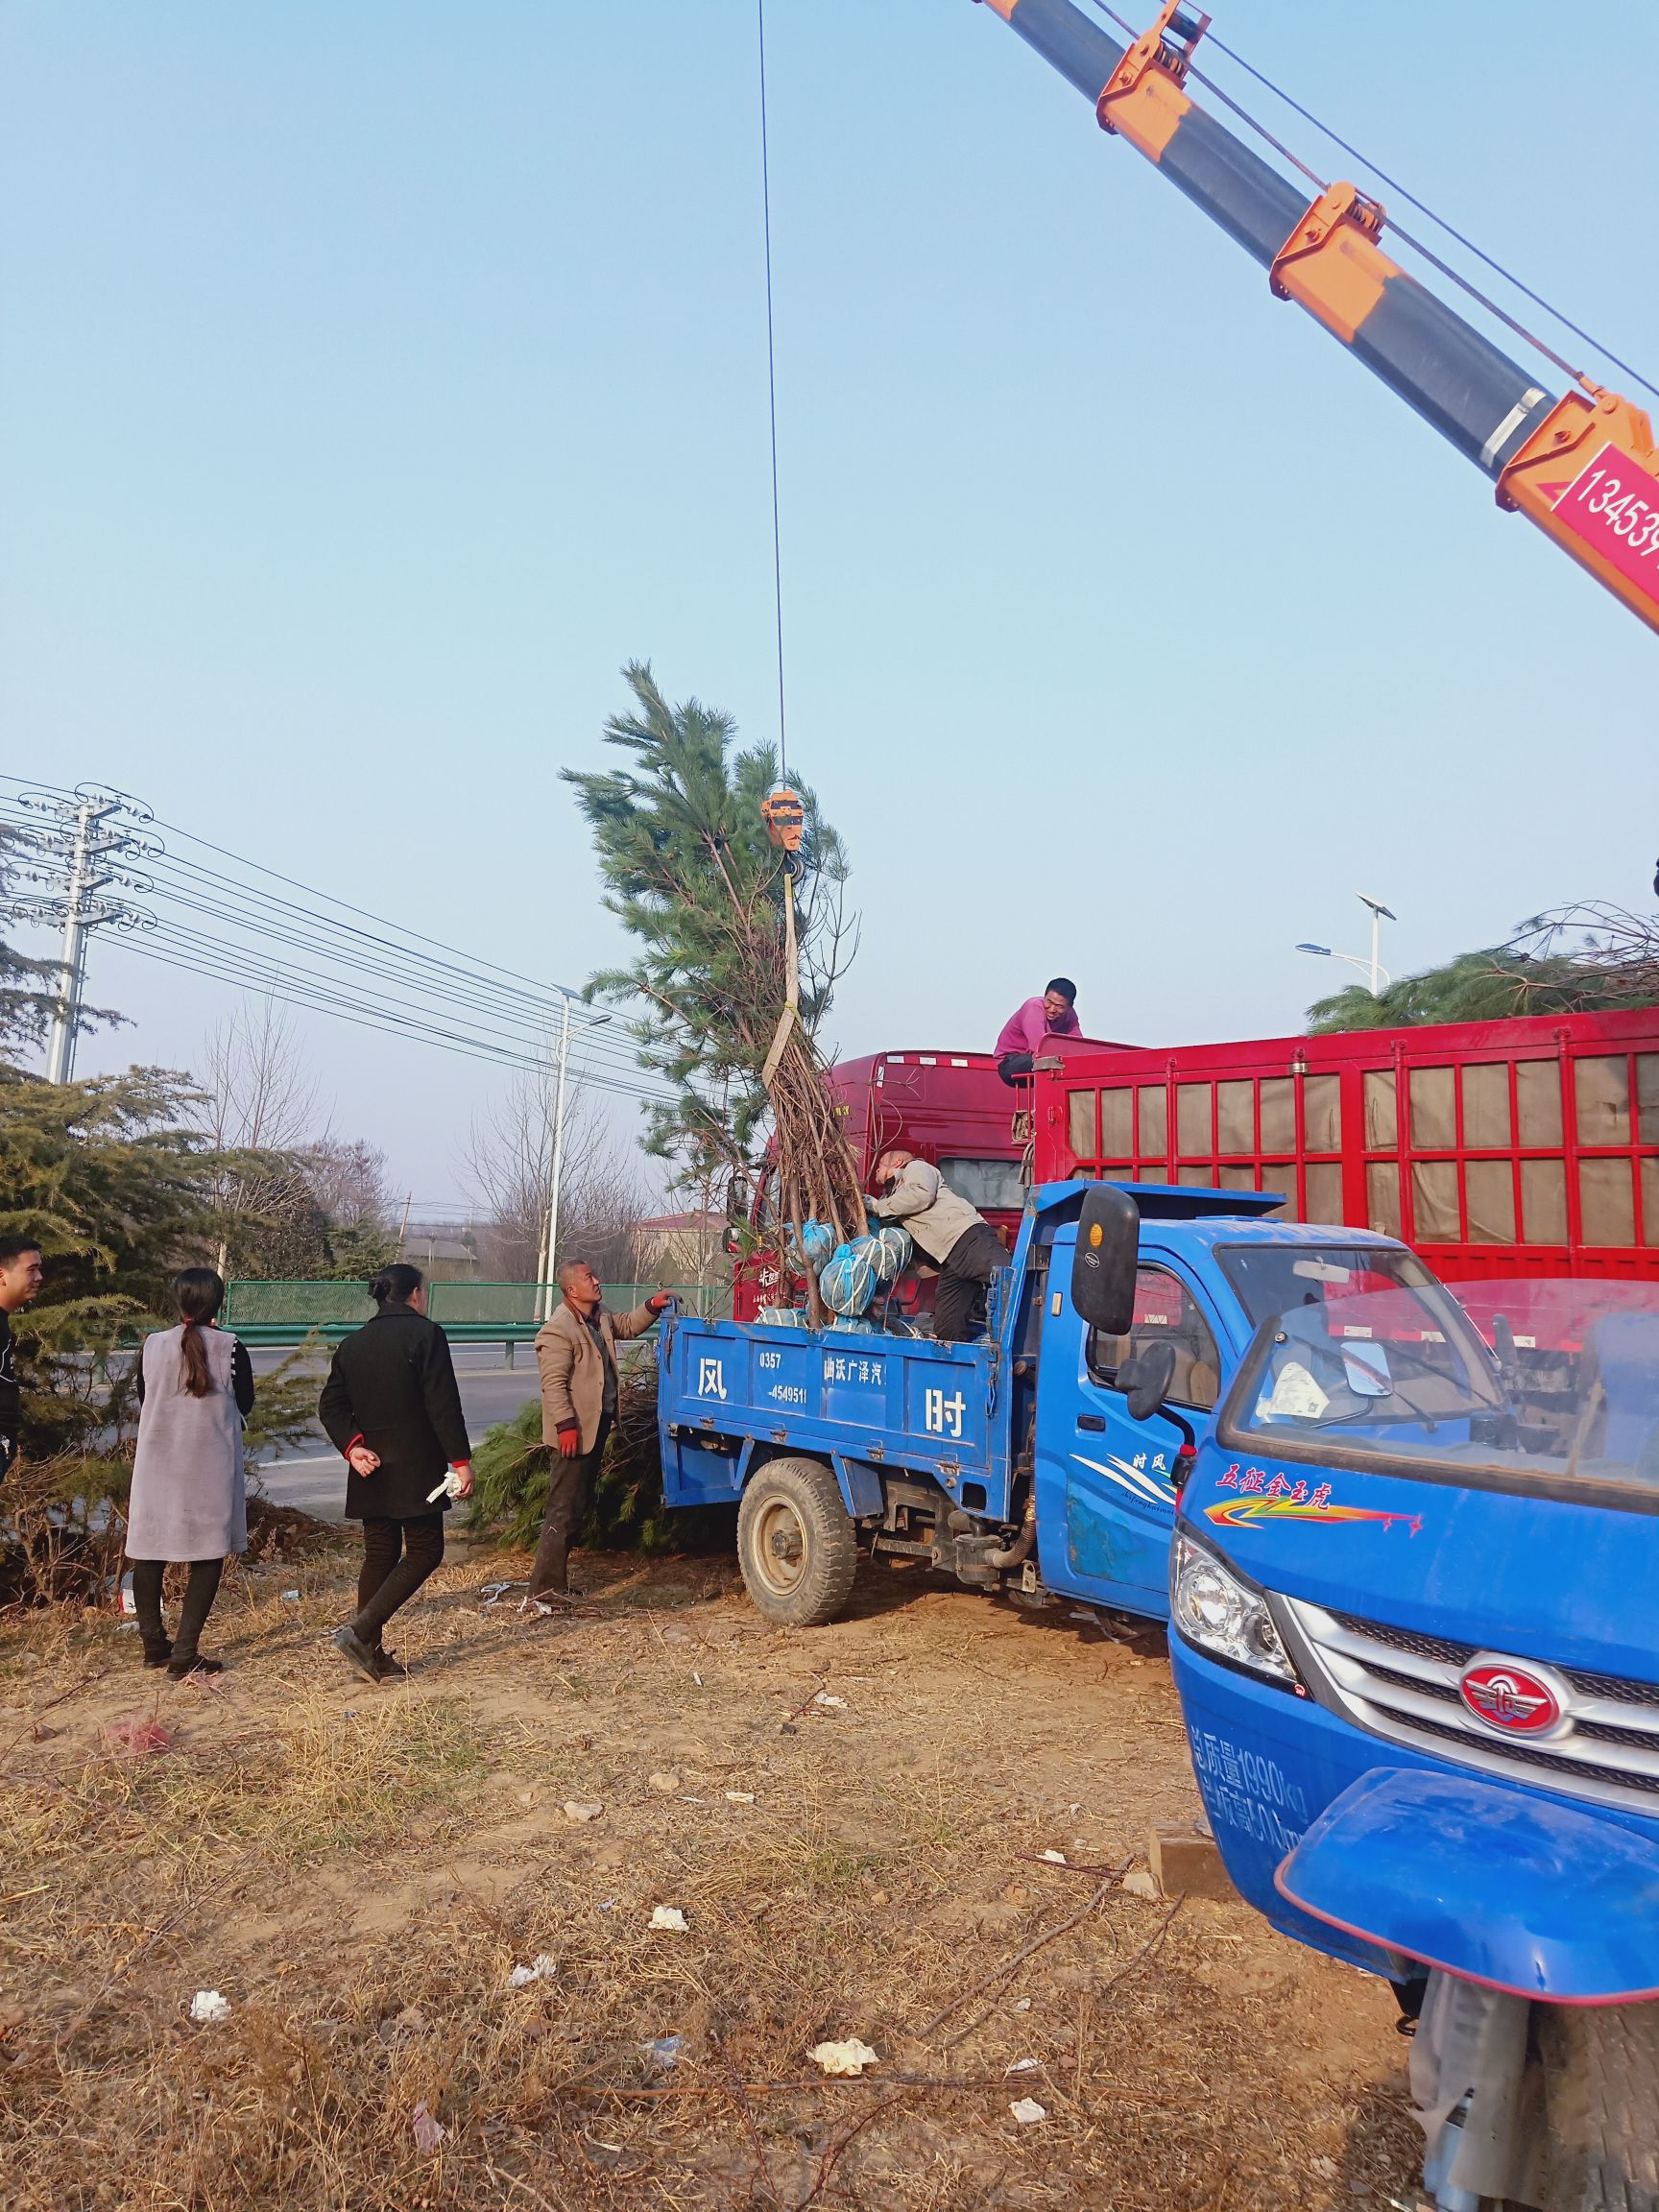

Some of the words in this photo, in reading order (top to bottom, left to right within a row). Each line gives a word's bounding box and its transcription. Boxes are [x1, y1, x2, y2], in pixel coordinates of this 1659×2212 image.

[1577, 469, 1659, 569] 134539
[759, 1352, 781, 1369] 0357
[824, 1357, 887, 1385] 曲沃广泽汽
[698, 1358, 728, 1400] 风
[926, 1388, 967, 1437] 时
[1132, 1452, 1166, 1471] 时风
